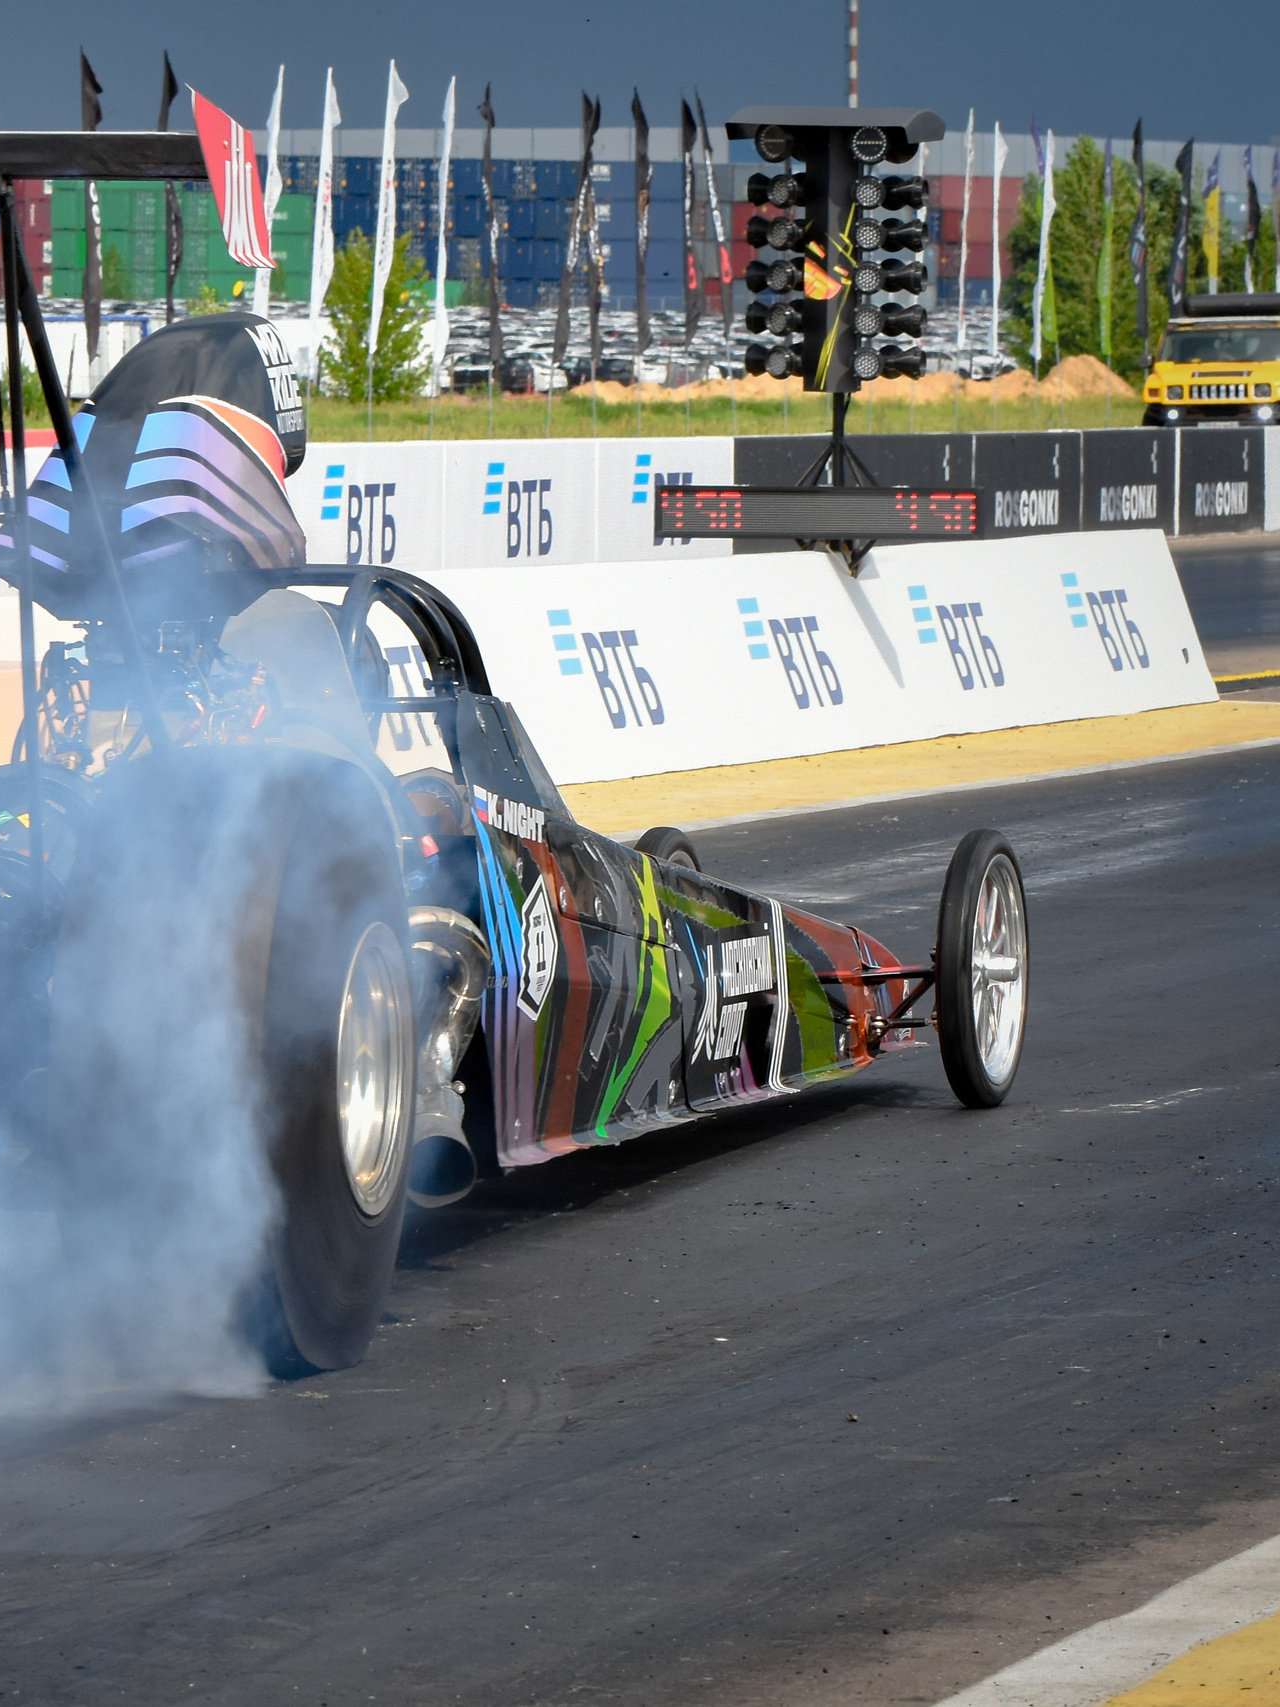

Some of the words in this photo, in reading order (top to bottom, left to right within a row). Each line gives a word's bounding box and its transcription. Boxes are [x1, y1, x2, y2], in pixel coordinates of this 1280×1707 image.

[346, 482, 397, 565] ВТБ
[507, 478, 553, 559] ВТБ
[994, 488, 1060, 528] ROSGONKI
[1100, 484, 1158, 522] ROSGONKI
[1195, 481, 1249, 517] ROSGONKI
[768, 615, 844, 710] ВТБ
[936, 602, 1006, 691] ВТБ
[1085, 588, 1150, 672] ВТБ
[581, 629, 666, 729] ВТБ
[714, 1001, 748, 1061] СПОРТ
